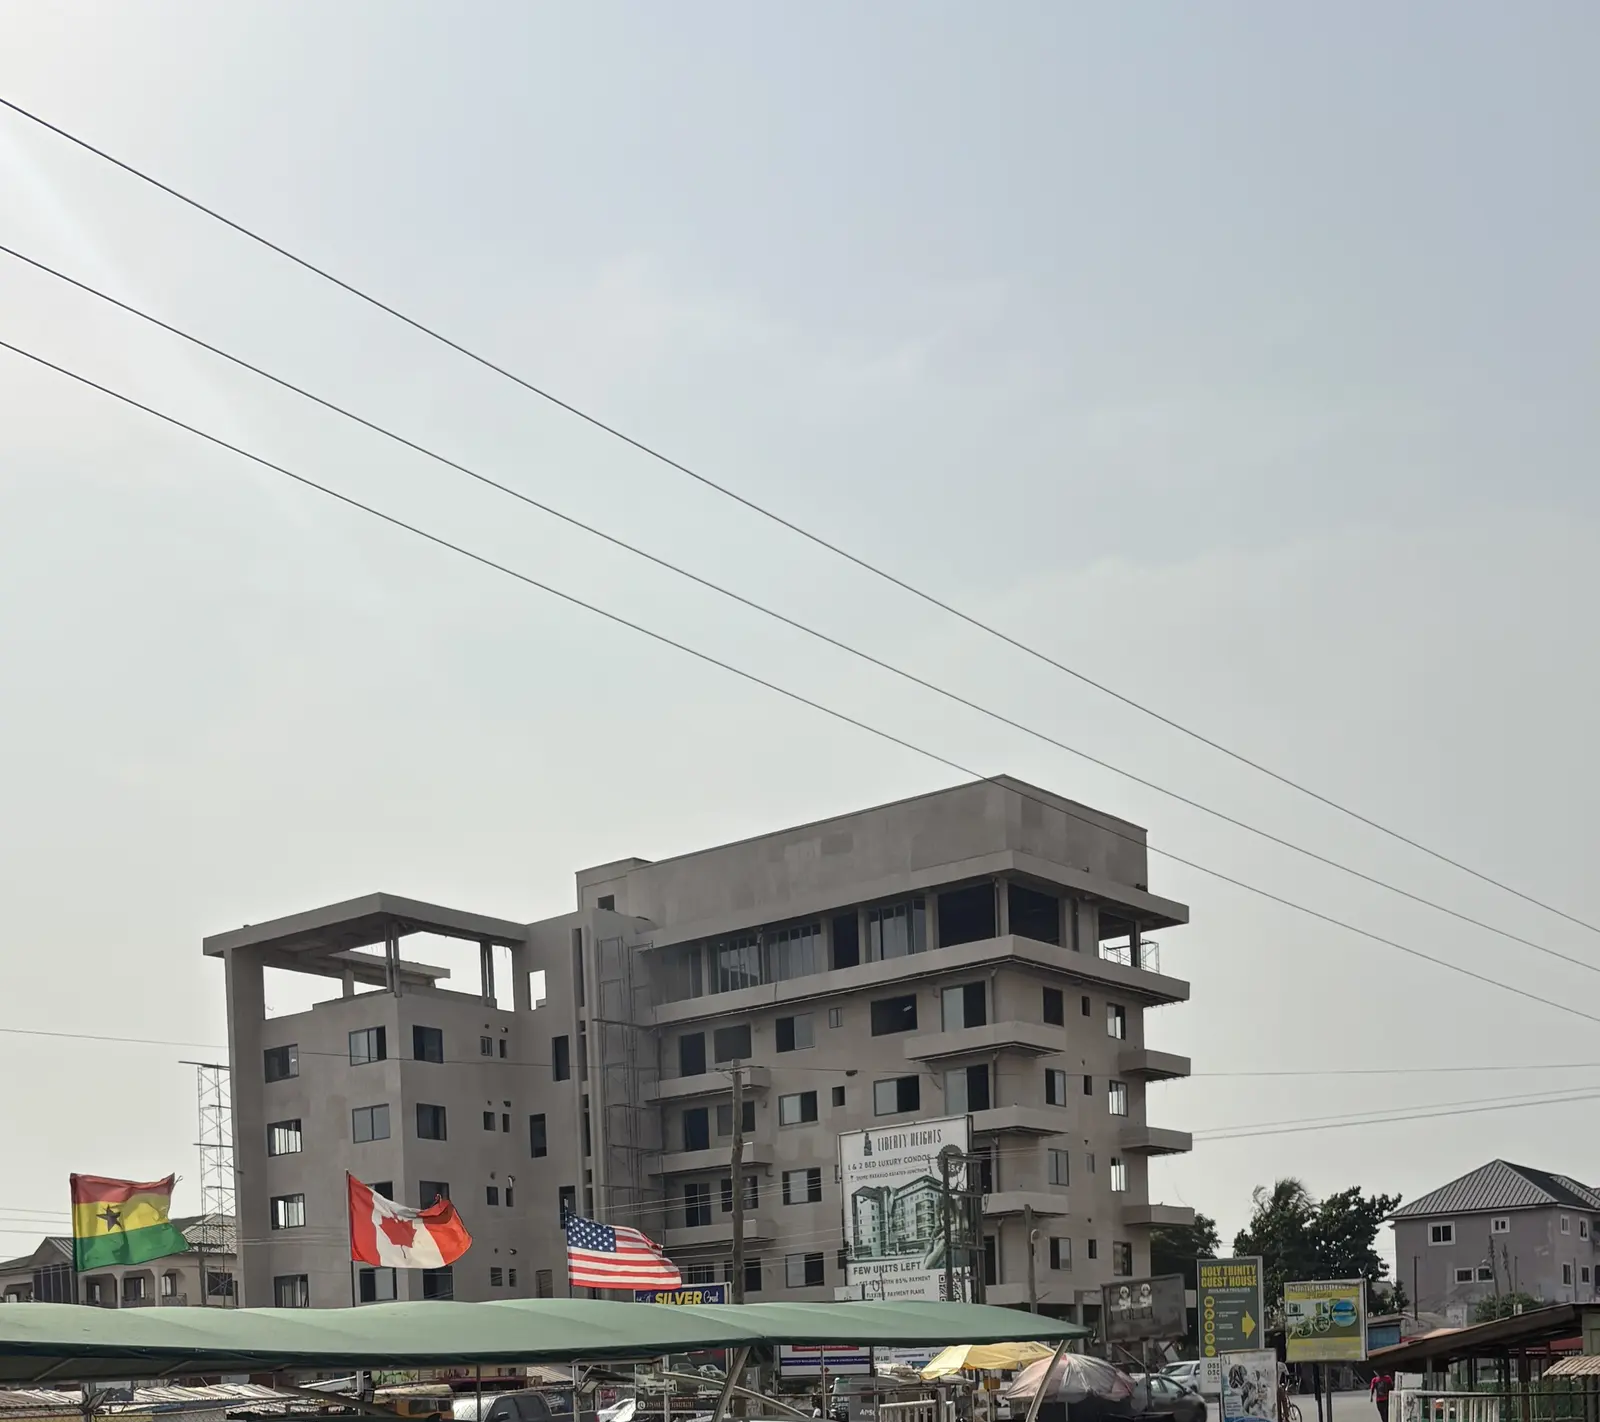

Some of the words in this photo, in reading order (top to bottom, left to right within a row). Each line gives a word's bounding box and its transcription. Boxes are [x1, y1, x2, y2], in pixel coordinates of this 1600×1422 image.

[877, 1134, 908, 1152] LIBERTY
[910, 1129, 942, 1147] HEIGHTS
[864, 1160, 877, 1169] BED
[878, 1157, 902, 1167] LUXURY
[903, 1154, 931, 1164] CONDOS
[853, 1266, 872, 1275] FEW
[874, 1263, 899, 1274] UNITS
[900, 1261, 921, 1271] LEFT
[1201, 1265, 1222, 1277] HOLY
[1201, 1276, 1227, 1288] GUEST
[1229, 1275, 1257, 1287] HOUSE
[655, 1291, 702, 1305] SILVER
